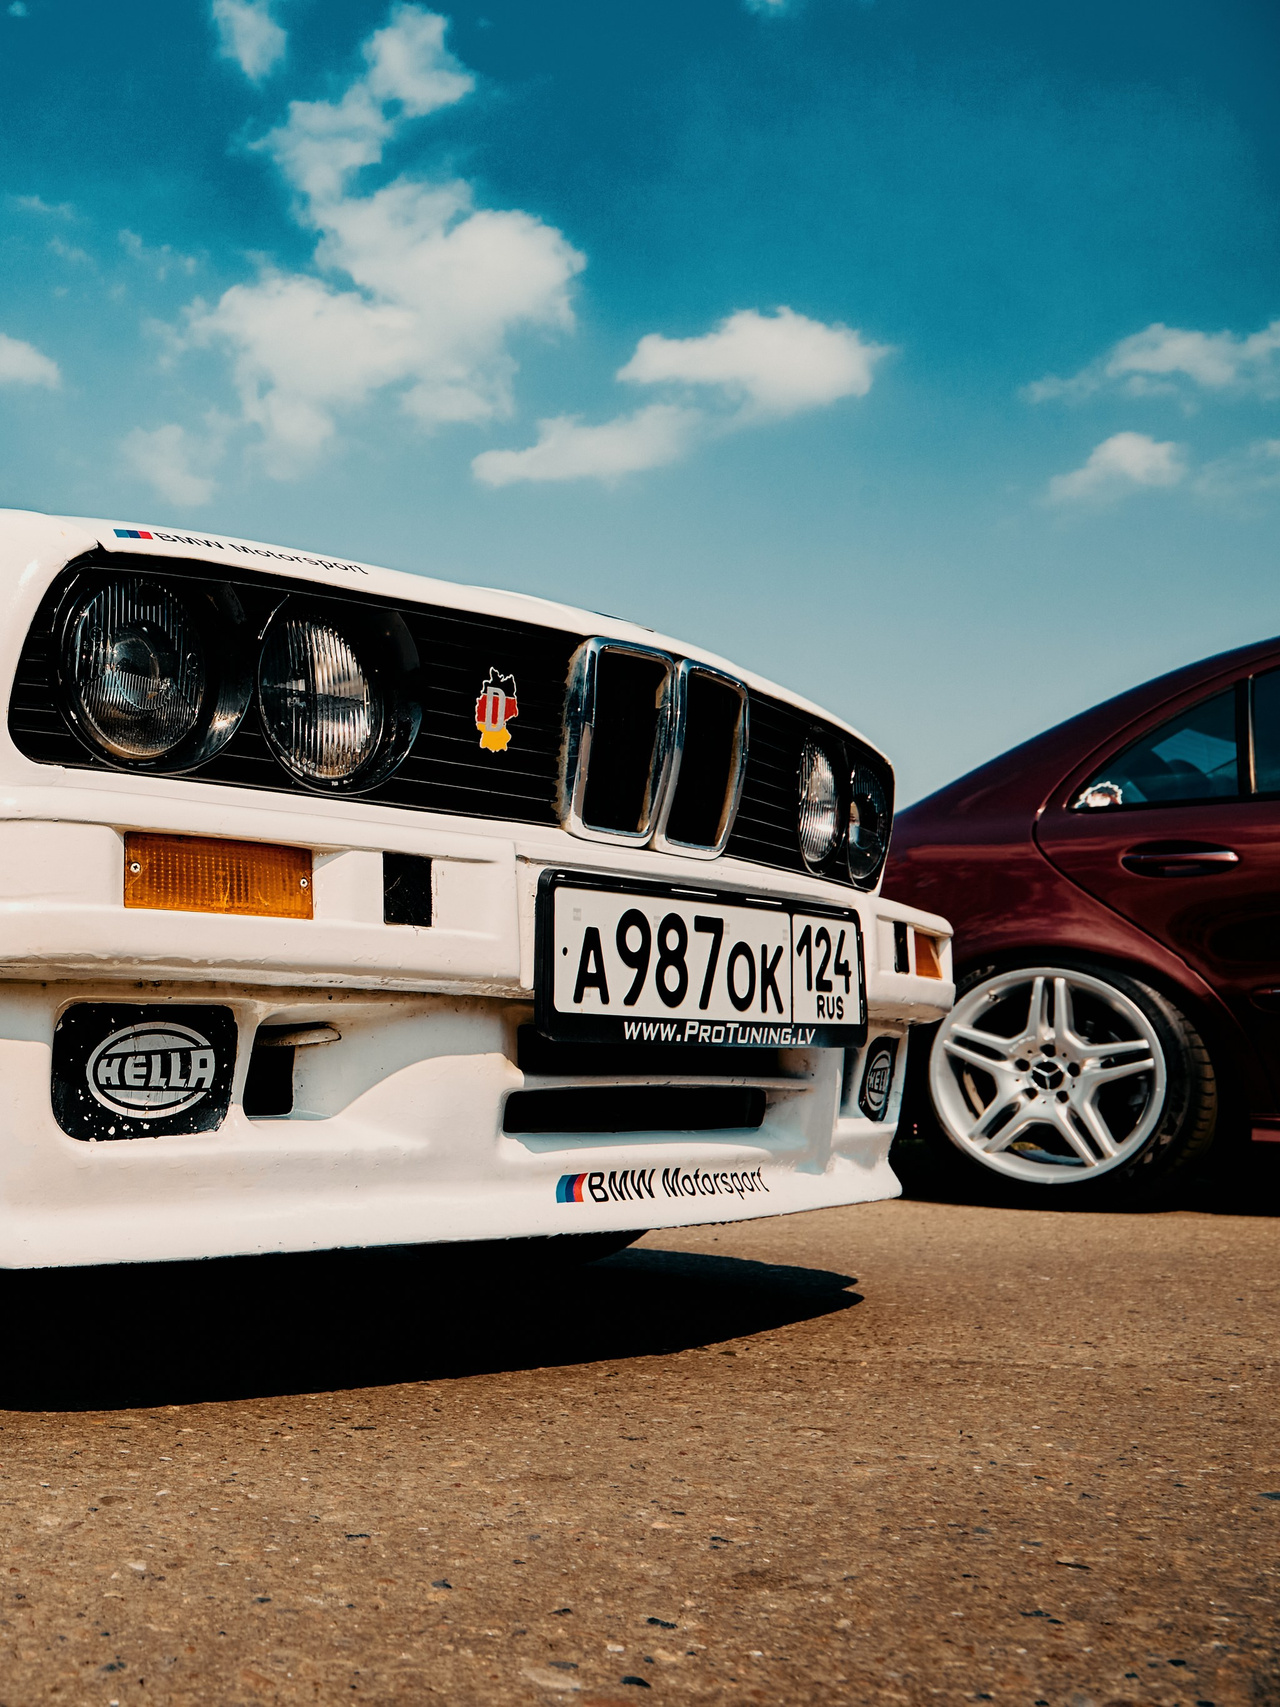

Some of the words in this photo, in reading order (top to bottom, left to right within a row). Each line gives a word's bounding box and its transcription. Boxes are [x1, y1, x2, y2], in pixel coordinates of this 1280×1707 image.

[153, 532, 225, 550] BMW
[228, 543, 369, 575] Motorsport
[485, 686, 506, 732] D
[573, 908, 784, 1015] A987OK
[796, 924, 852, 994] 124
[816, 994, 844, 1020] RUS
[97, 1049, 216, 1089] HELLA
[588, 1168, 656, 1203] BMW
[662, 1166, 770, 1200] Motorsport
